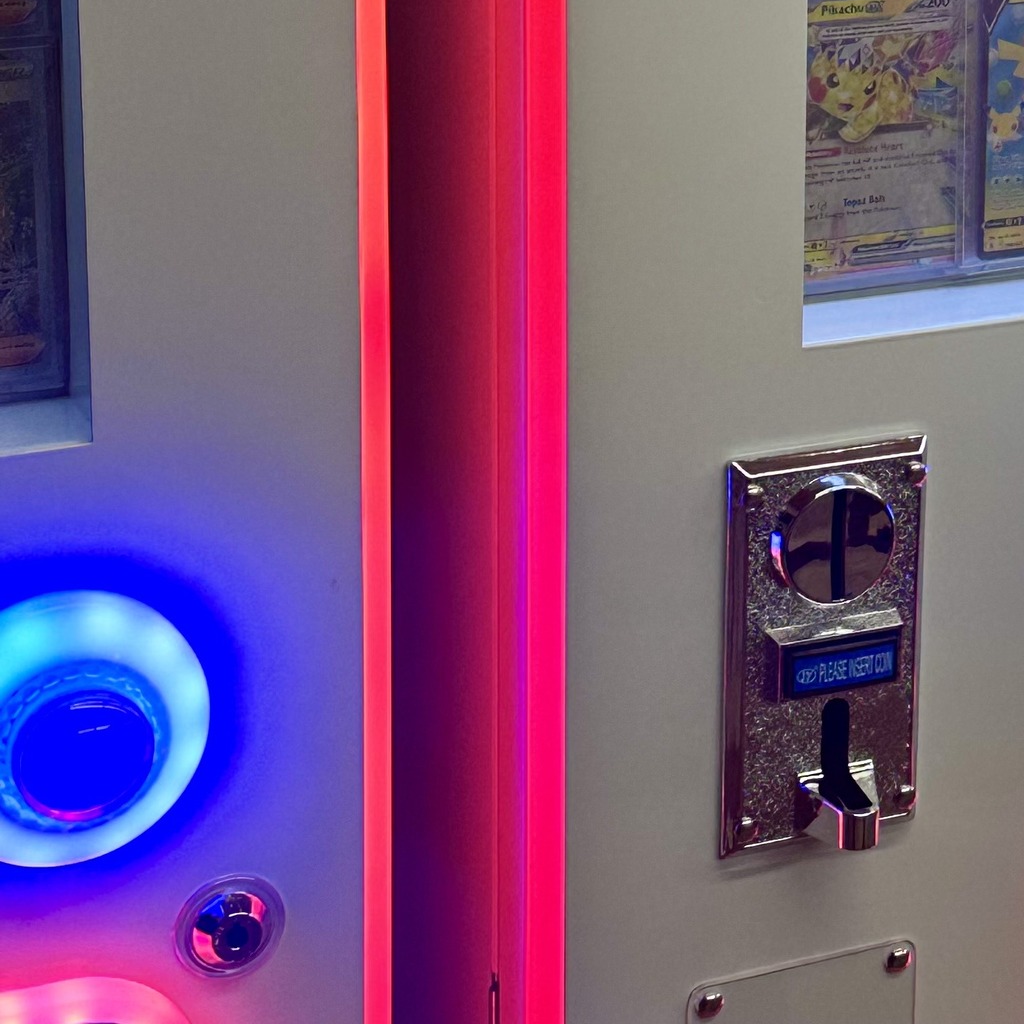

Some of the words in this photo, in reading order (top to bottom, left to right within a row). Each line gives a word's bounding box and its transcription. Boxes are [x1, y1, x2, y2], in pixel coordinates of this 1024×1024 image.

[821, 2, 864, 16] Pikachu
[819, 659, 848, 684] PLEASE
[848, 655, 874, 678] INSERT
[875, 651, 893, 674] COIN
